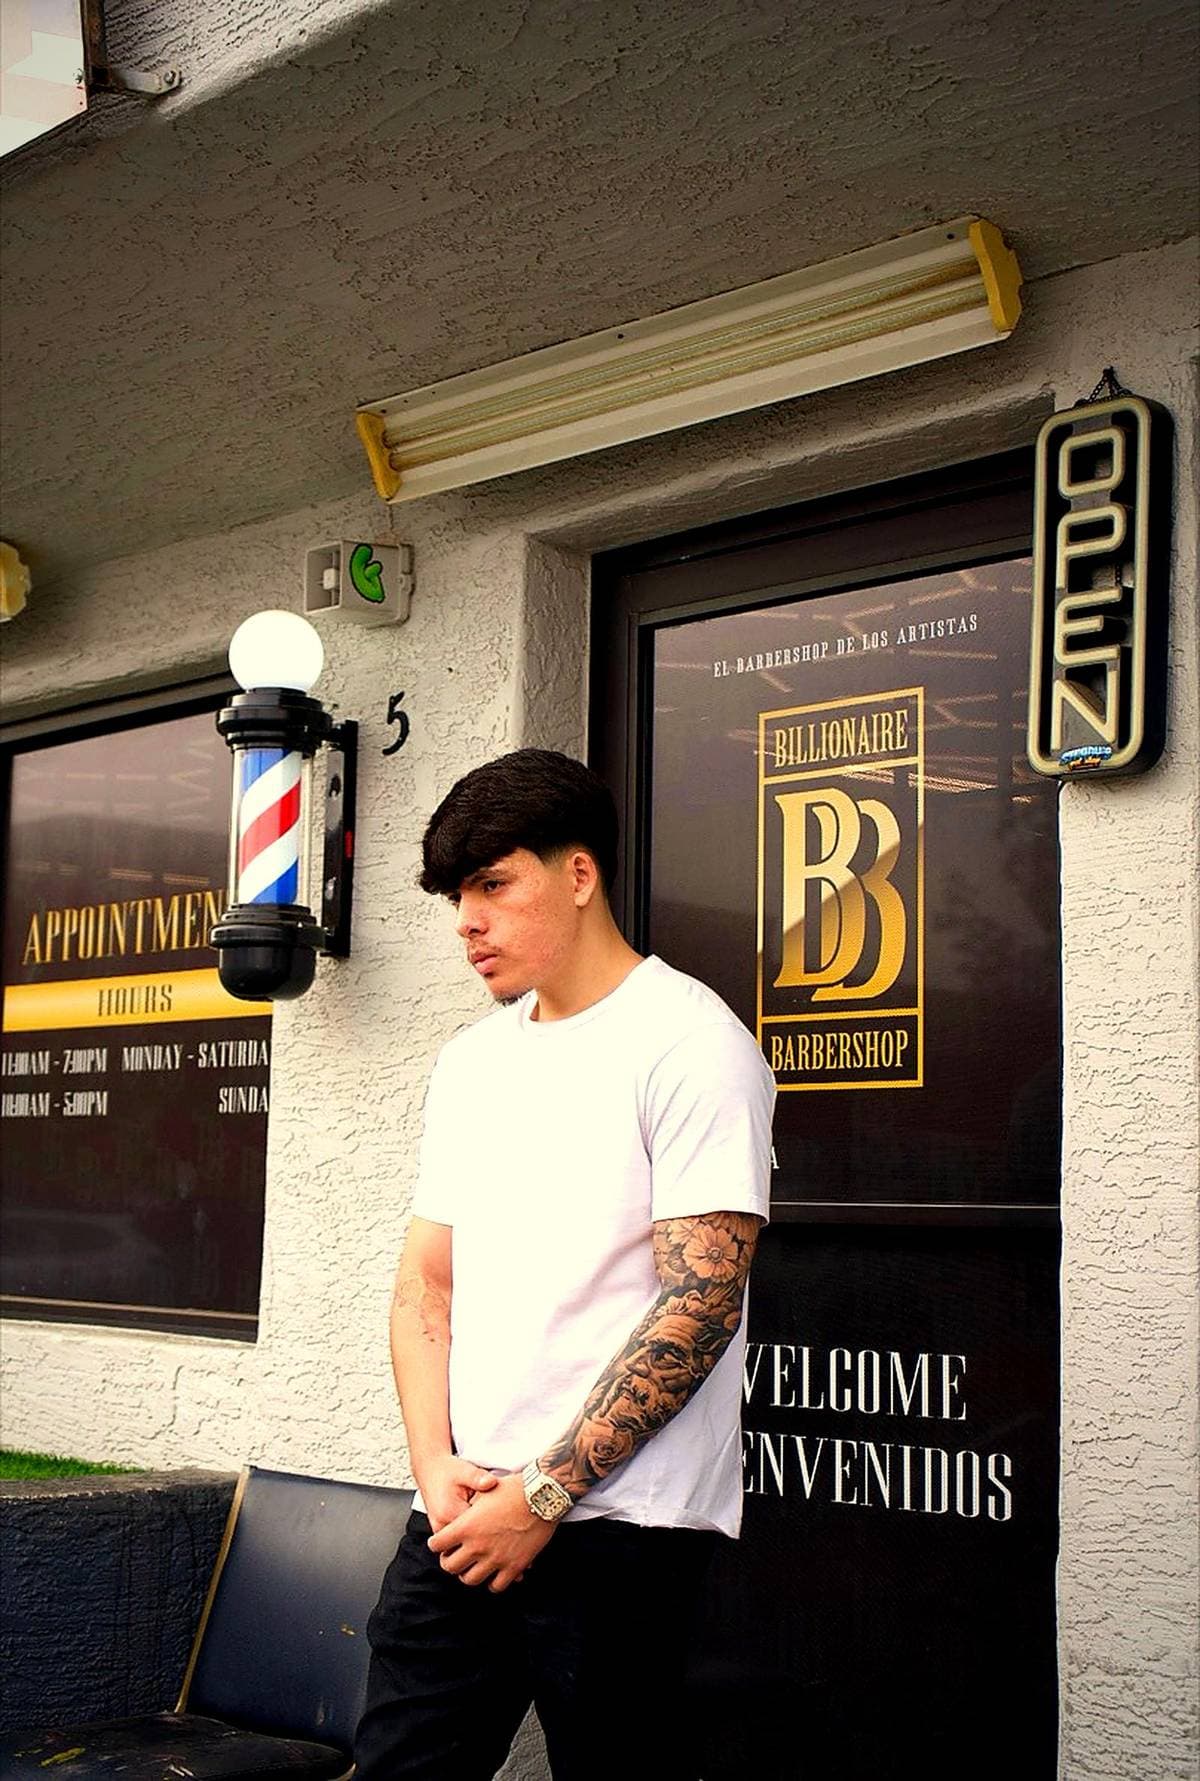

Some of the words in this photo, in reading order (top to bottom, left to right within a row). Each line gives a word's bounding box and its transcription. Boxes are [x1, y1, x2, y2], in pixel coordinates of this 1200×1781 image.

[1051, 426, 1126, 751] OPEN
[714, 661, 730, 677] EL
[737, 641, 828, 674] BARBERSHOP
[837, 636, 855, 655] DE
[862, 630, 888, 650] LOS
[897, 614, 978, 645] ARTISTAS
[382, 692, 410, 756] 5
[774, 709, 908, 769] BILLIONAIRE
[98, 984, 173, 1017] HOURS
[62, 1048, 107, 1074] 7:00PM
[121, 1044, 183, 1071] MONDAY
[771, 1029, 909, 1072] BARBERSHOP
[62, 1091, 107, 1116] 5:00PM
